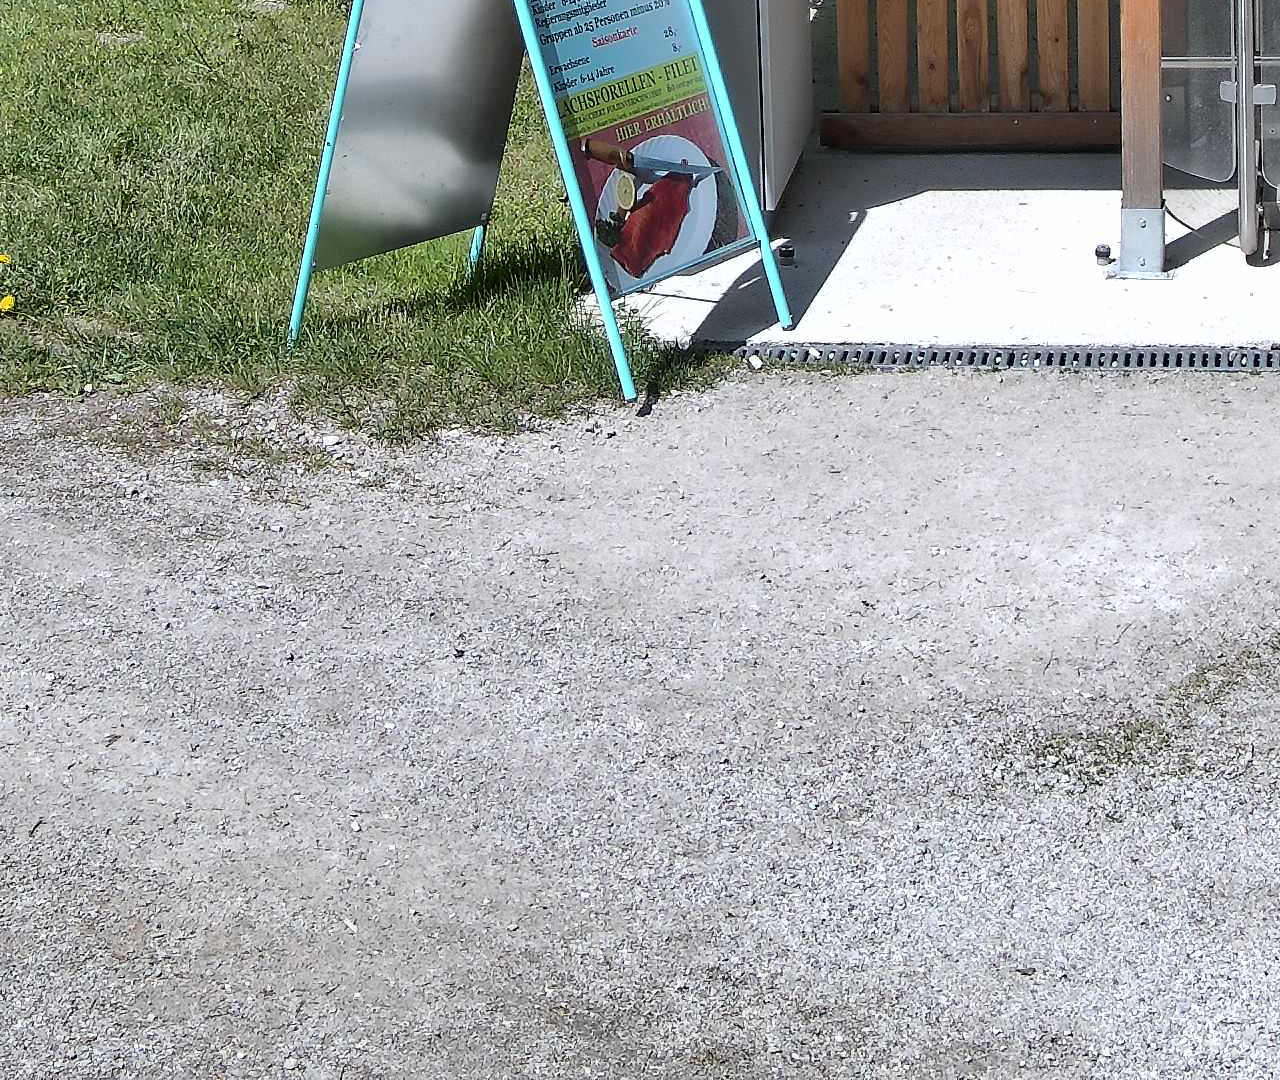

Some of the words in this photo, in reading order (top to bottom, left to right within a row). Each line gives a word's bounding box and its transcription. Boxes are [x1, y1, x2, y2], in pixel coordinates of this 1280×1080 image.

[531, 0, 556, 16] Kinder
[539, 28, 573, 47] Gruppen
[574, 21, 584, 35] ab
[584, 21, 595, 33] 25
[594, 9, 629, 29] Personen
[630, 0, 654, 16] minus
[591, 26, 639, 48] Saisonkarte
[549, 55, 591, 76] Erwachsene
[552, 78, 578, 93] Kinder
[595, 64, 616, 79] Jahre
[556, 70, 656, 119] LACHSFORELLEN
[664, 56, 698, 81] FILET
[615, 123, 640, 142] HIER
